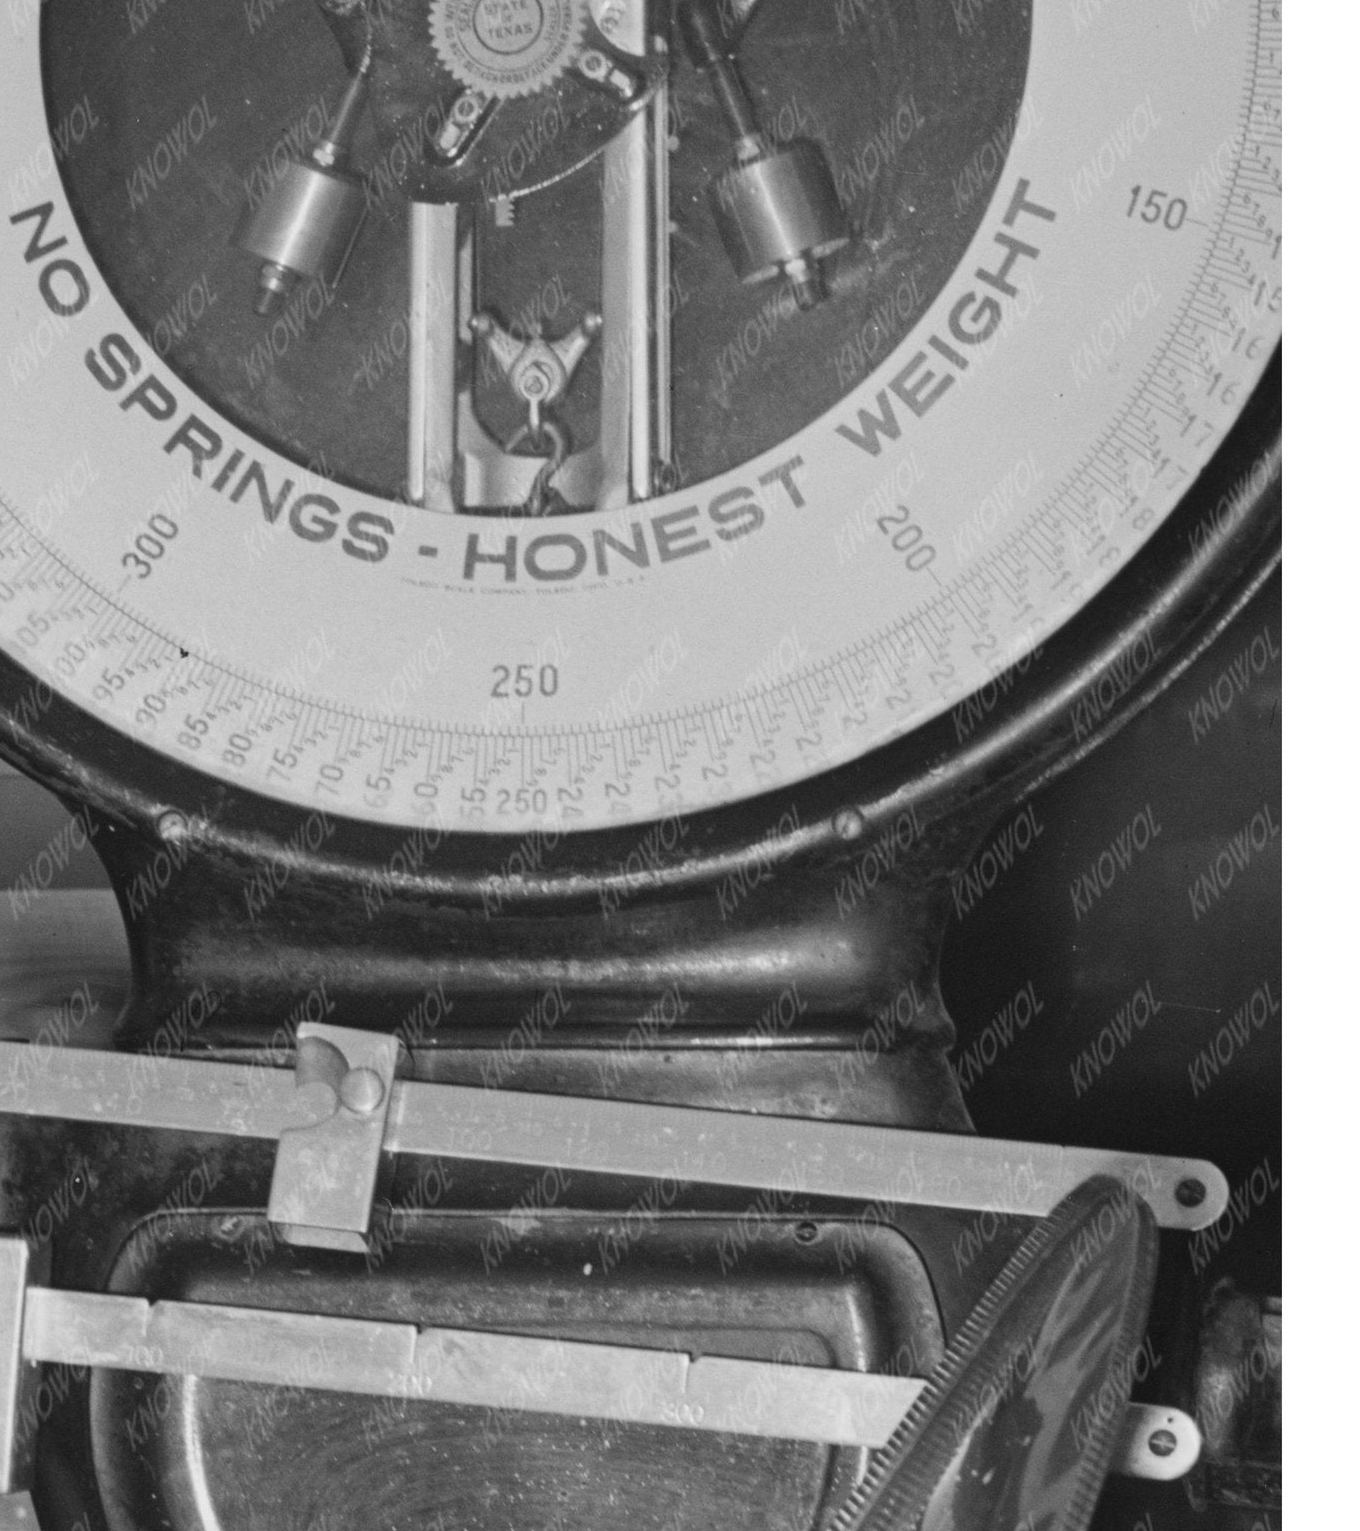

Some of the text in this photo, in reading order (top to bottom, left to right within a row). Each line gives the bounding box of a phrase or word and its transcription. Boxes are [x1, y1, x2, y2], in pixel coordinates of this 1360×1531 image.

[488, 23, 533, 39] TEXAS
[1127, 184, 1188, 231] 150
[10, 201, 91, 318] NO
[84, 332, 396, 563] SPRINGS
[462, 454, 807, 584] HONEST
[836, 178, 1058, 461] WEIGHT
[122, 513, 179, 579] 300
[876, 505, 937, 572] 200
[16, 613, 50, 648] 05
[55, 643, 86, 678] 00
[93, 670, 125, 704] 95
[490, 664, 559, 698] 250
[135, 693, 167, 726] 90
[179, 714, 209, 752] 85
[222, 734, 253, 767] 80
[266, 749, 299, 782] 75
[316, 764, 344, 797] 70
[496, 789, 548, 815] 250
